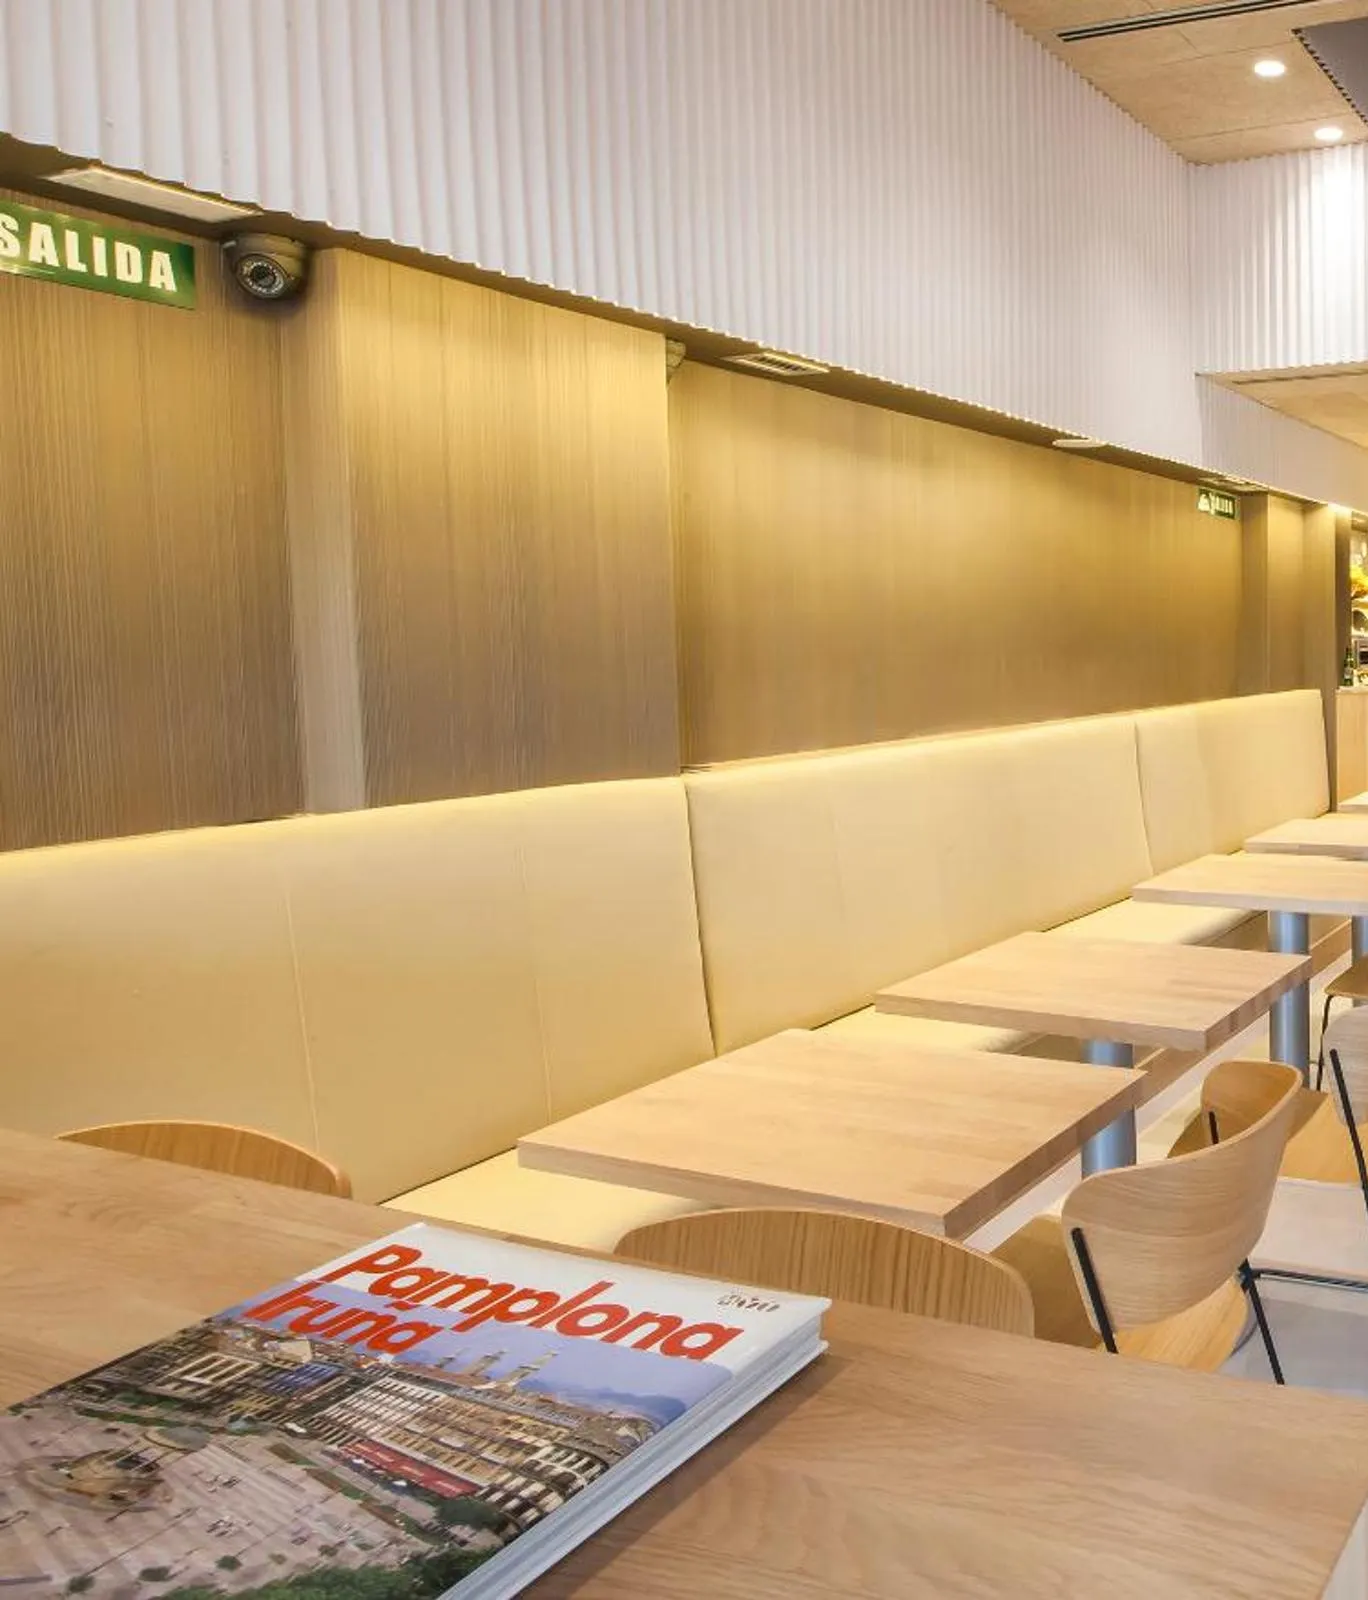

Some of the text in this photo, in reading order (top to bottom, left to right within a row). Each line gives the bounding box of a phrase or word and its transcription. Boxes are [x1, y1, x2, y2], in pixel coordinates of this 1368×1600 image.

[0, 213, 177, 293] SALIDA
[243, 1280, 444, 1355] Iruña
[320, 1243, 744, 1362] Pamplona
